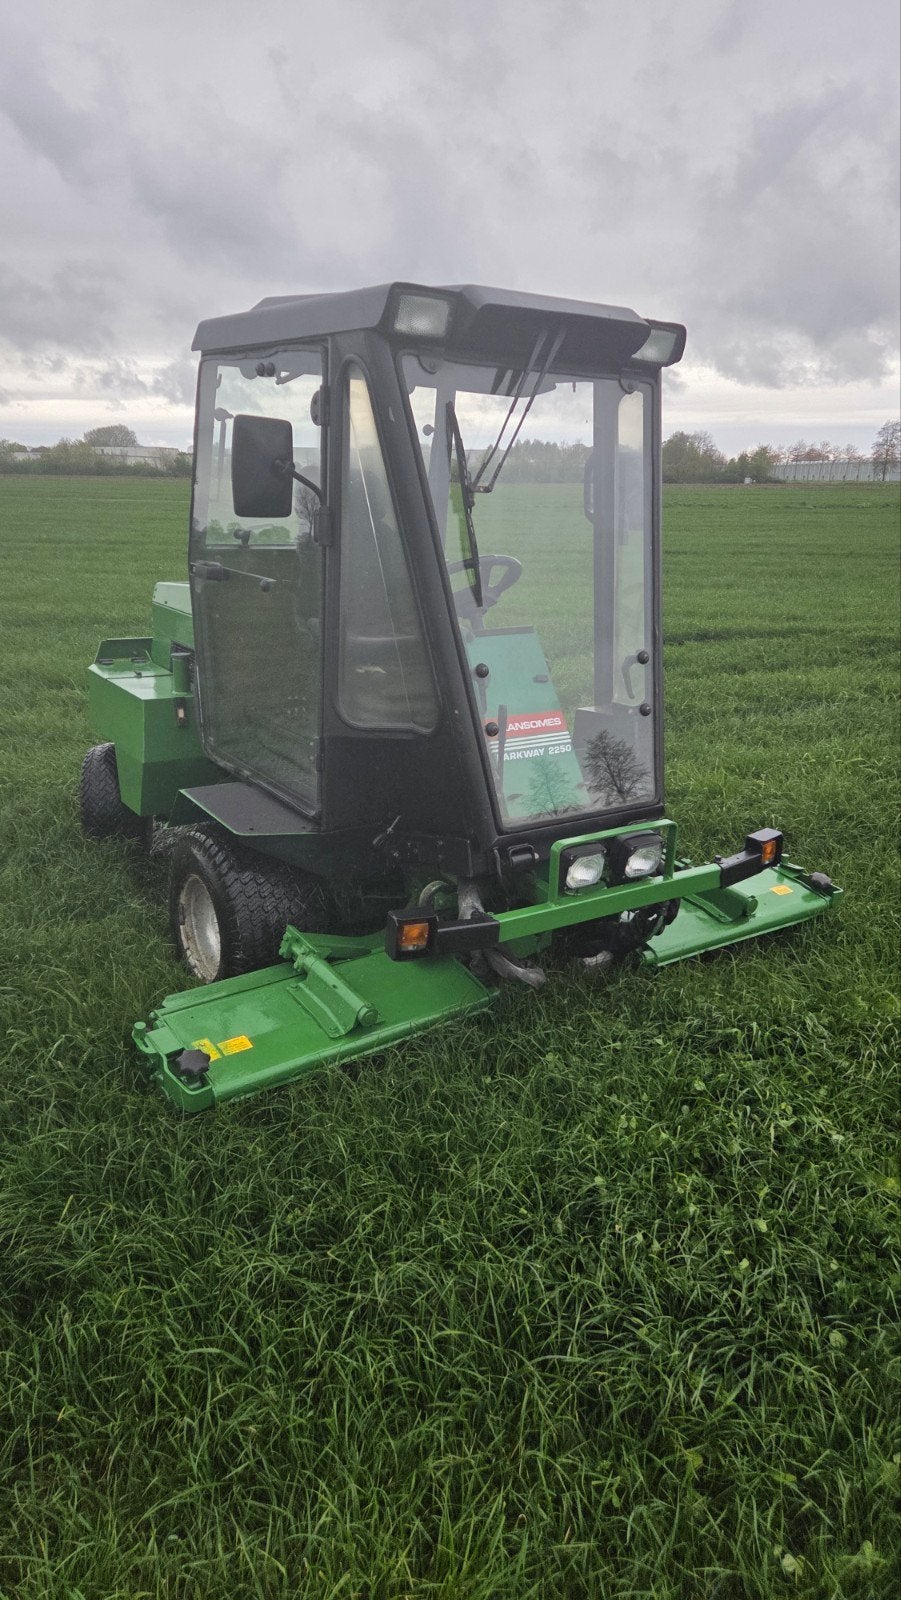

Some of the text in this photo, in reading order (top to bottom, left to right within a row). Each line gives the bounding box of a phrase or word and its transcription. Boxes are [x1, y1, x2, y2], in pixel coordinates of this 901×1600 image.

[505, 717, 562, 732] ANSOMES
[497, 744, 572, 761] ARKWAY 2250
